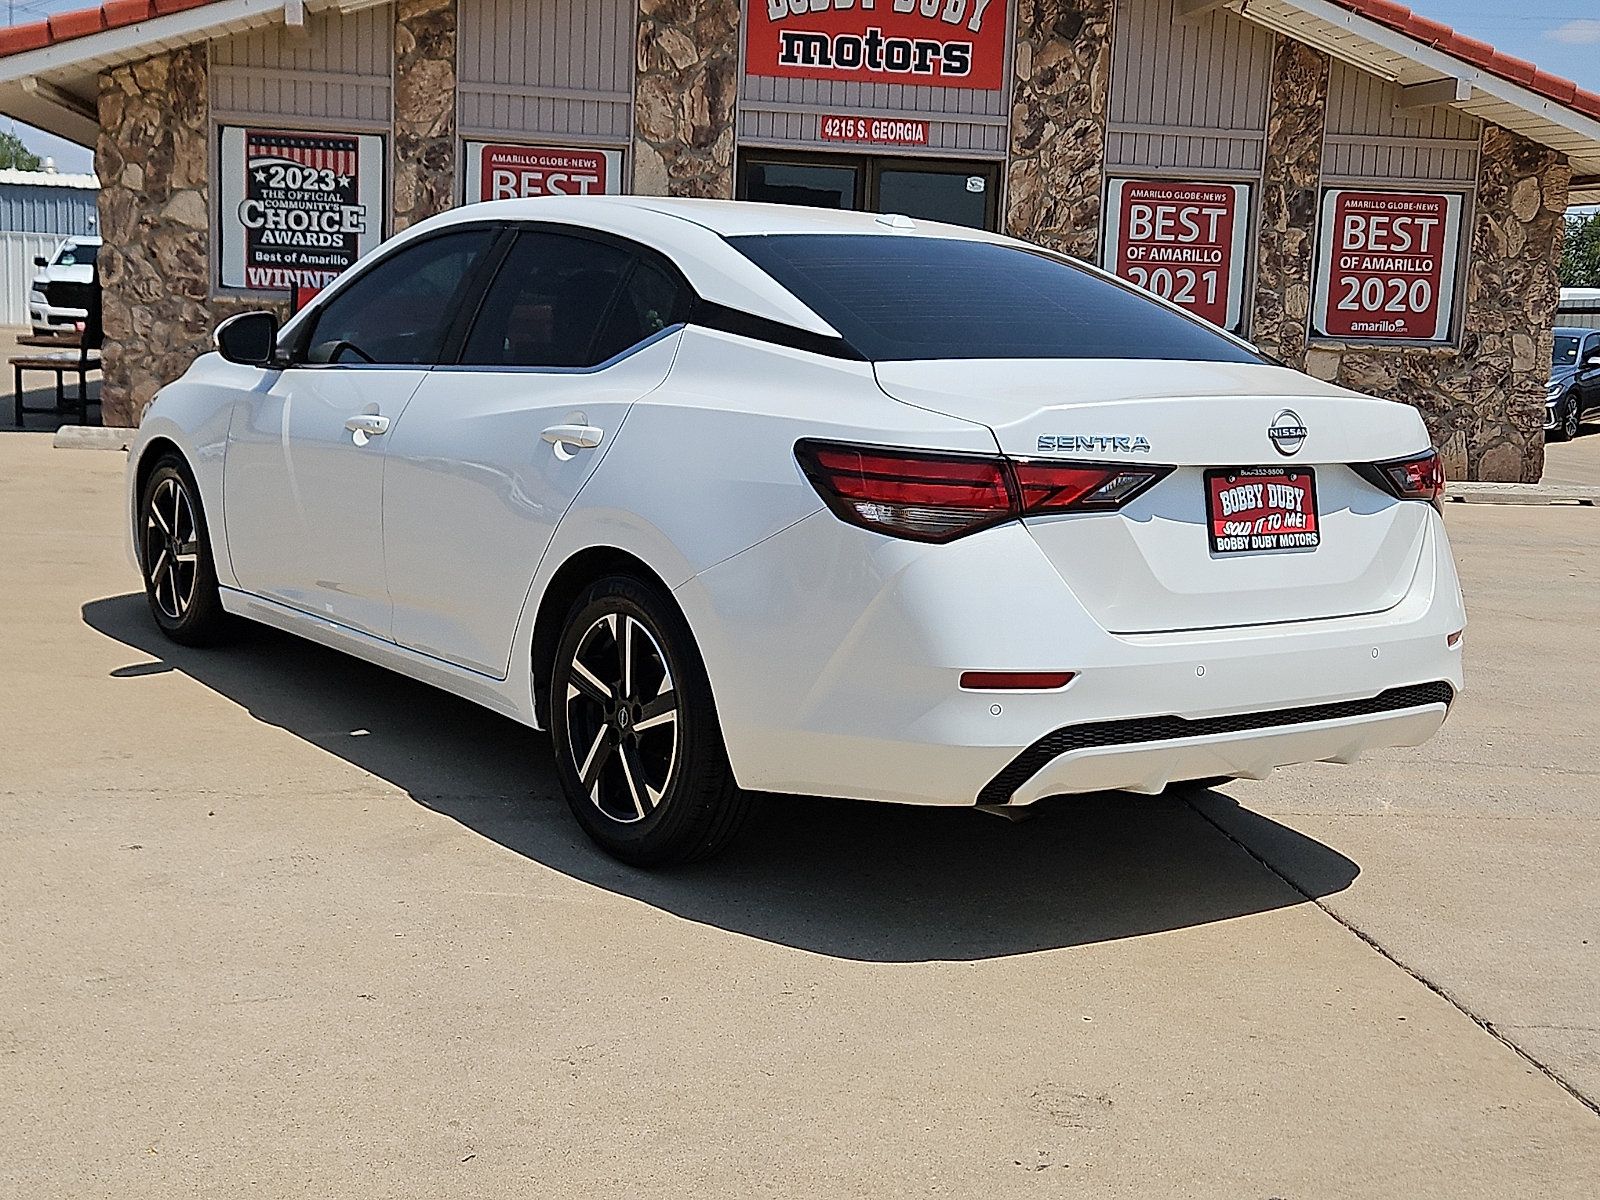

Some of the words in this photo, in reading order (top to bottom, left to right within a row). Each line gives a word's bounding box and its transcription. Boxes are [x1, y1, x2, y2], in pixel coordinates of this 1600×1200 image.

[778, 27, 973, 77] motors
[824, 118, 854, 138] 4215
[857, 122, 868, 138] S.
[871, 123, 924, 142] GEORGIA
[491, 153, 538, 165] AMARILLO
[539, 156, 597, 168] GLOBE-NEWS
[269, 166, 336, 191] 2023
[492, 170, 598, 200] BEST
[261, 189, 285, 199] THE
[288, 190, 344, 203] OFFICIAL
[265, 200, 340, 211] COMMUNITY'S
[1130, 189, 1172, 199] AMARILLO
[1174, 191, 1227, 202] GLOBE-NEWS
[238, 199, 366, 233] CHOICE
[1344, 200, 1386, 209] AMARILLO
[1387, 202, 1439, 212] GLOBE-NEWS
[1129, 204, 1227, 243] BEST
[261, 230, 344, 247] AWARDS
[1342, 215, 1439, 253] BEST
[255, 251, 281, 262] Best
[284, 252, 297, 262] of
[300, 253, 349, 265] Amarillo
[1127, 247, 1146, 260] OF
[1149, 248, 1222, 263] AMARILLO
[1340, 256, 1359, 269] OF
[1362, 257, 1433, 272] AMARILLO
[247, 267, 342, 288] WINNE
[1127, 267, 1217, 304] 2021
[1337, 276, 1432, 313] 2020
[1269, 428, 1308, 437] NISSAN
[1037, 435, 1151, 453] SENTRA
[1219, 483, 1263, 516] BOBBY
[1267, 483, 1304, 511] DUBY
[1222, 521, 1252, 536] SOLD
[1253, 517, 1266, 535] IT
[1267, 512, 1282, 530] TO
[1216, 536, 1249, 551] BOBBY
[1251, 535, 1277, 549] DUBY
[1279, 532, 1318, 547] MOTORS
